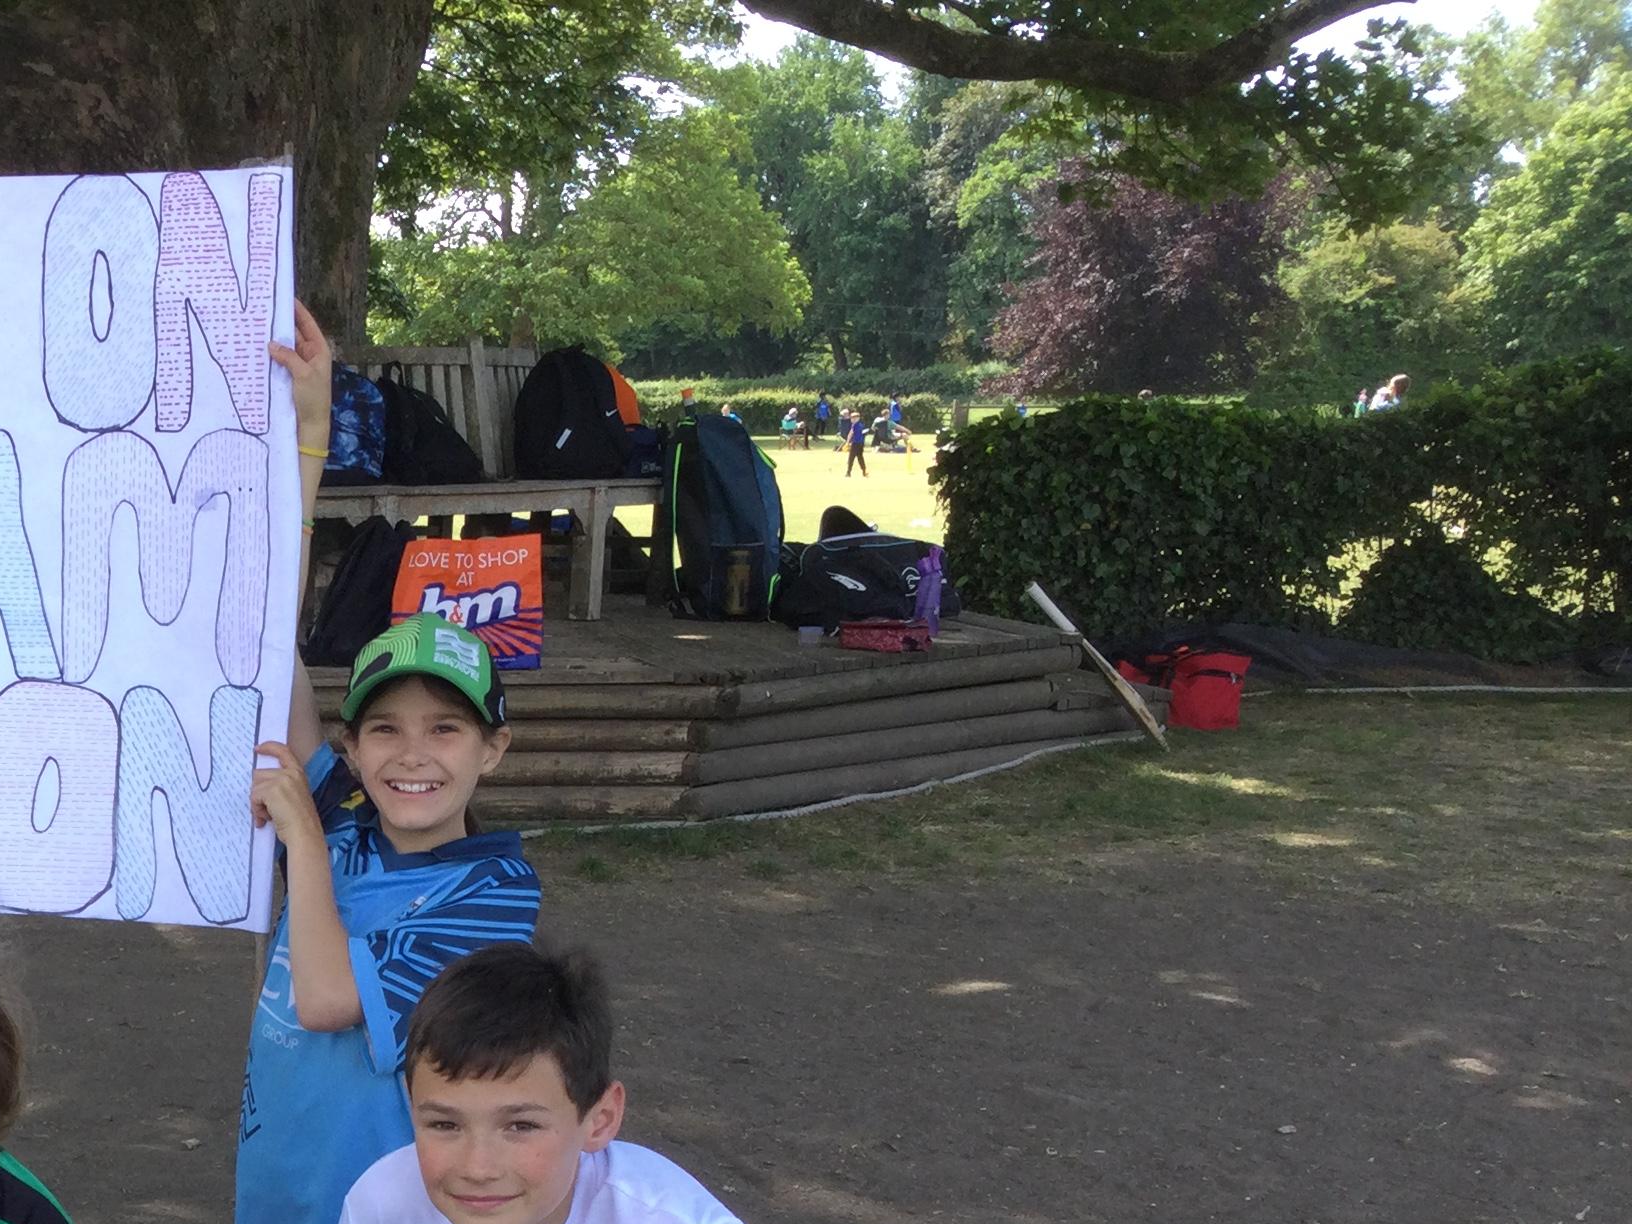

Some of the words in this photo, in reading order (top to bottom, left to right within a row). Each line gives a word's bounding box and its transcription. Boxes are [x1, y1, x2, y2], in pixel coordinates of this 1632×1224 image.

[42, 171, 284, 434] ON
[408, 552, 450, 569] LOVE
[455, 553, 474, 569] TO
[478, 549, 529, 569] SHOP
[456, 572, 475, 586] AT
[261, 1024, 299, 1051] GROUP
